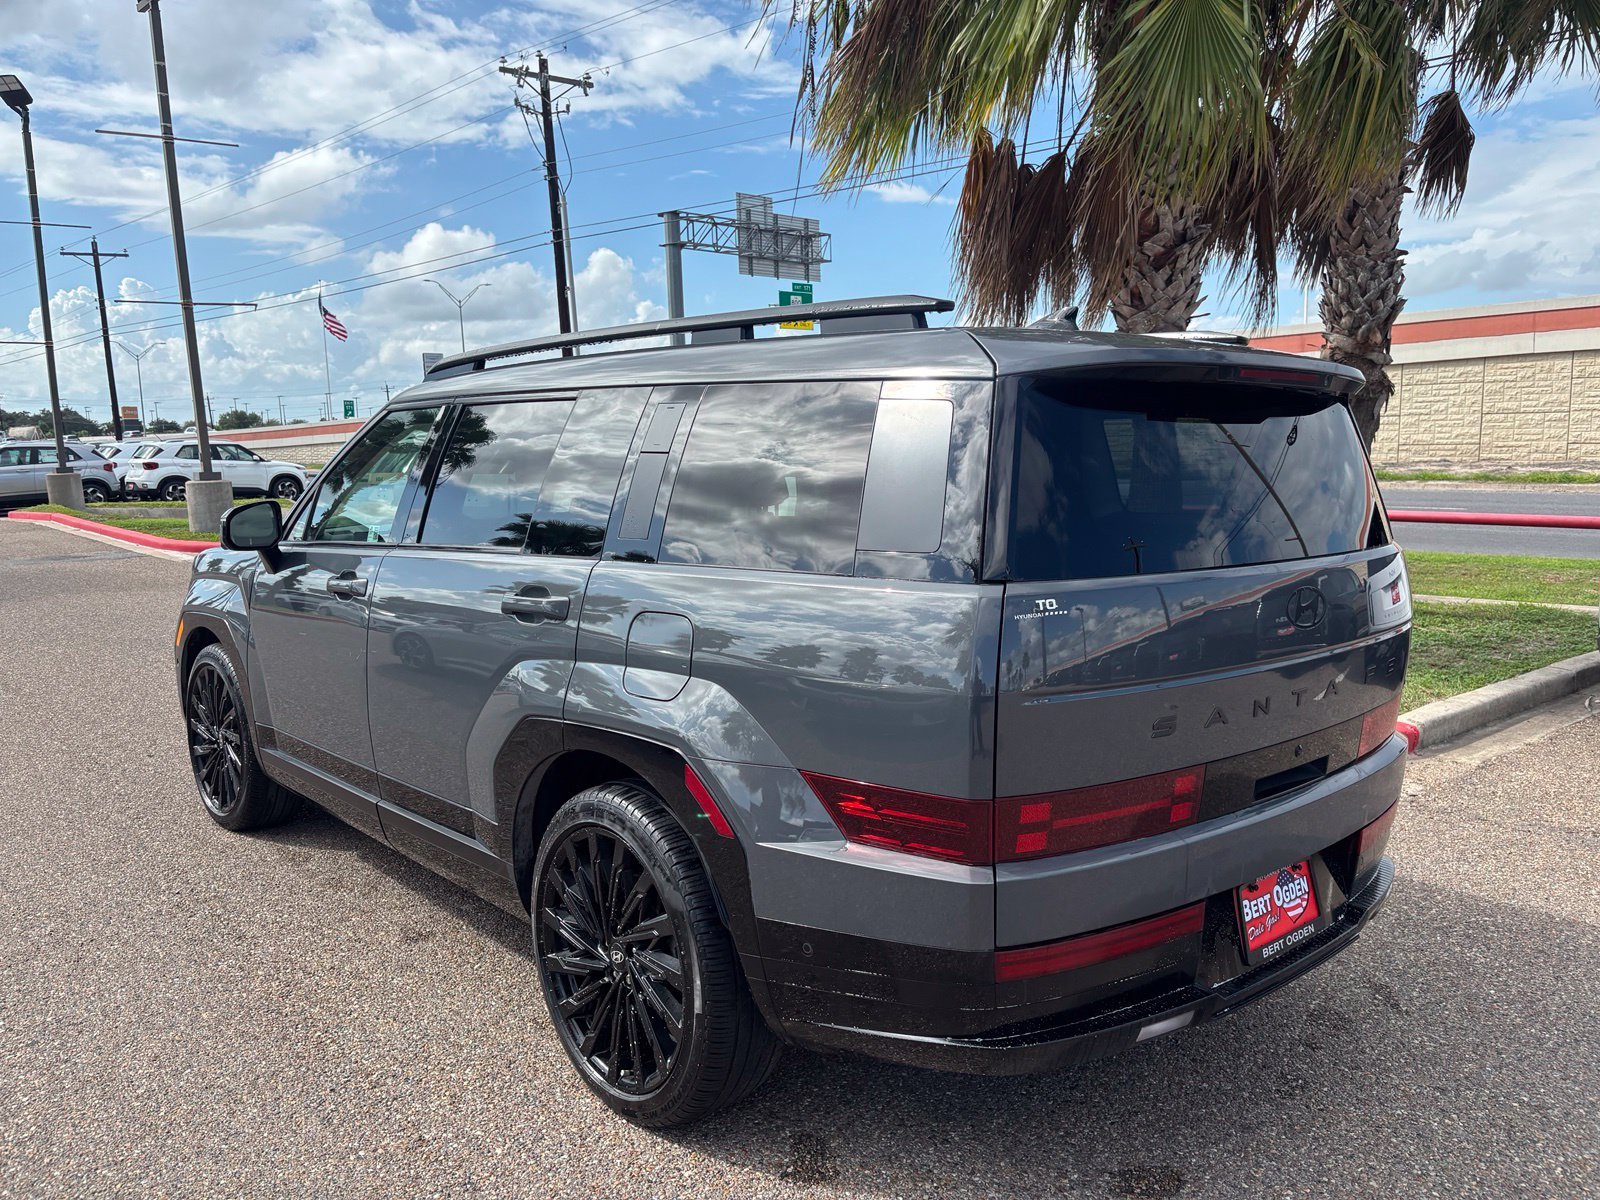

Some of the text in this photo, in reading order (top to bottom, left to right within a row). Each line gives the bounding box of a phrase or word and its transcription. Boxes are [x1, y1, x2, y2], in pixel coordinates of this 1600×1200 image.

[1014, 612, 1044, 620] HYUNDAI
[1151, 678, 1339, 739] SANTA
[1243, 876, 1309, 922] BERT OGDEN
[1262, 924, 1315, 958] BERT OGDEN
